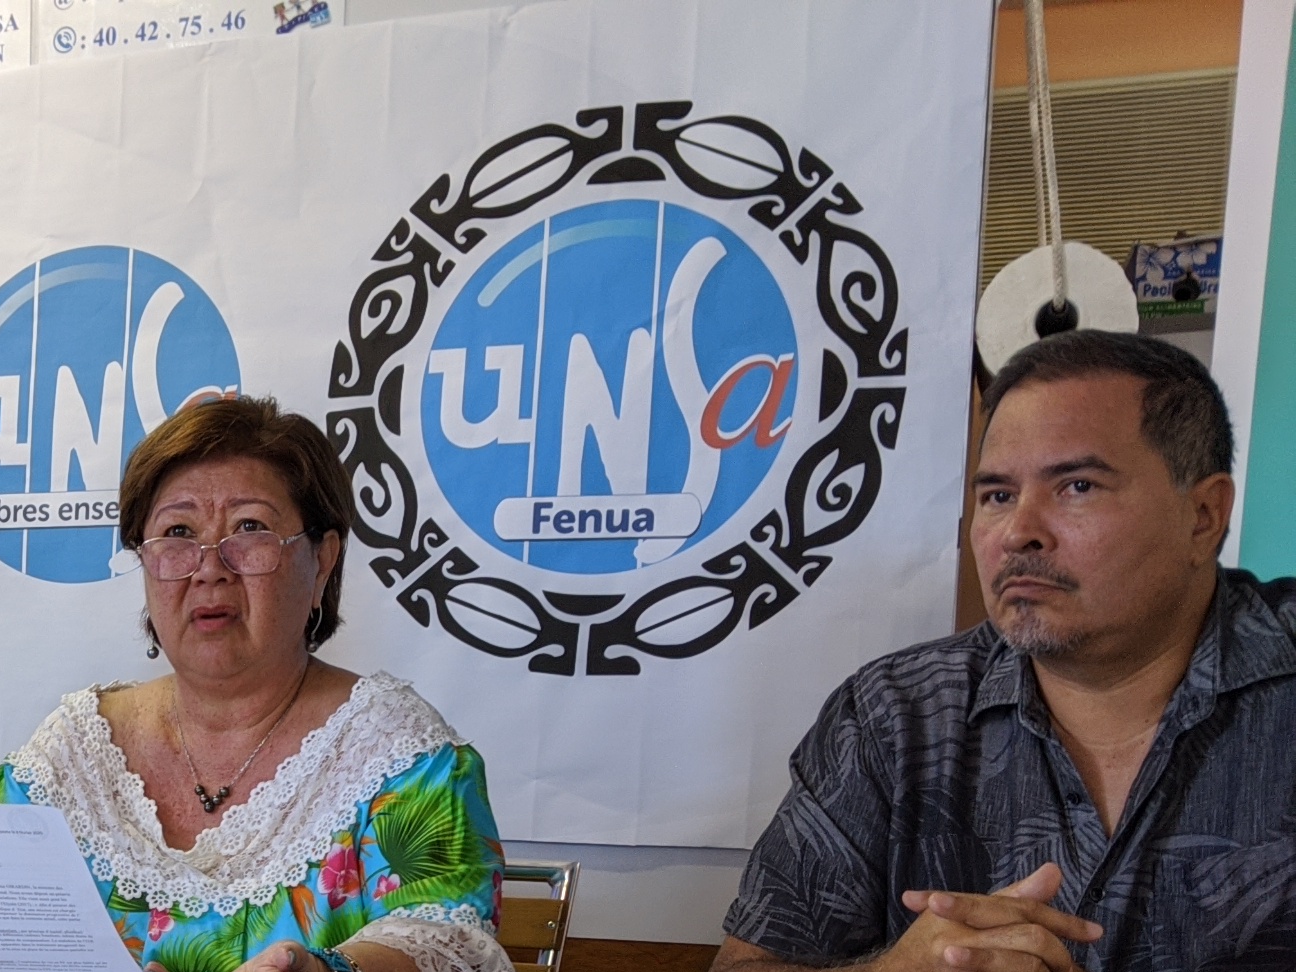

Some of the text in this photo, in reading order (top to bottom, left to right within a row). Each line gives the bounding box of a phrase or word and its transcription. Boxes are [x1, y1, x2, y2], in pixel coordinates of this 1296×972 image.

[93, 26, 117, 46] 40
[135, 21, 159, 42] 42
[178, 15, 203, 37] 75
[221, 10, 246, 31] 46
[57, 500, 120, 521] ense
[532, 502, 655, 534] Fenua
